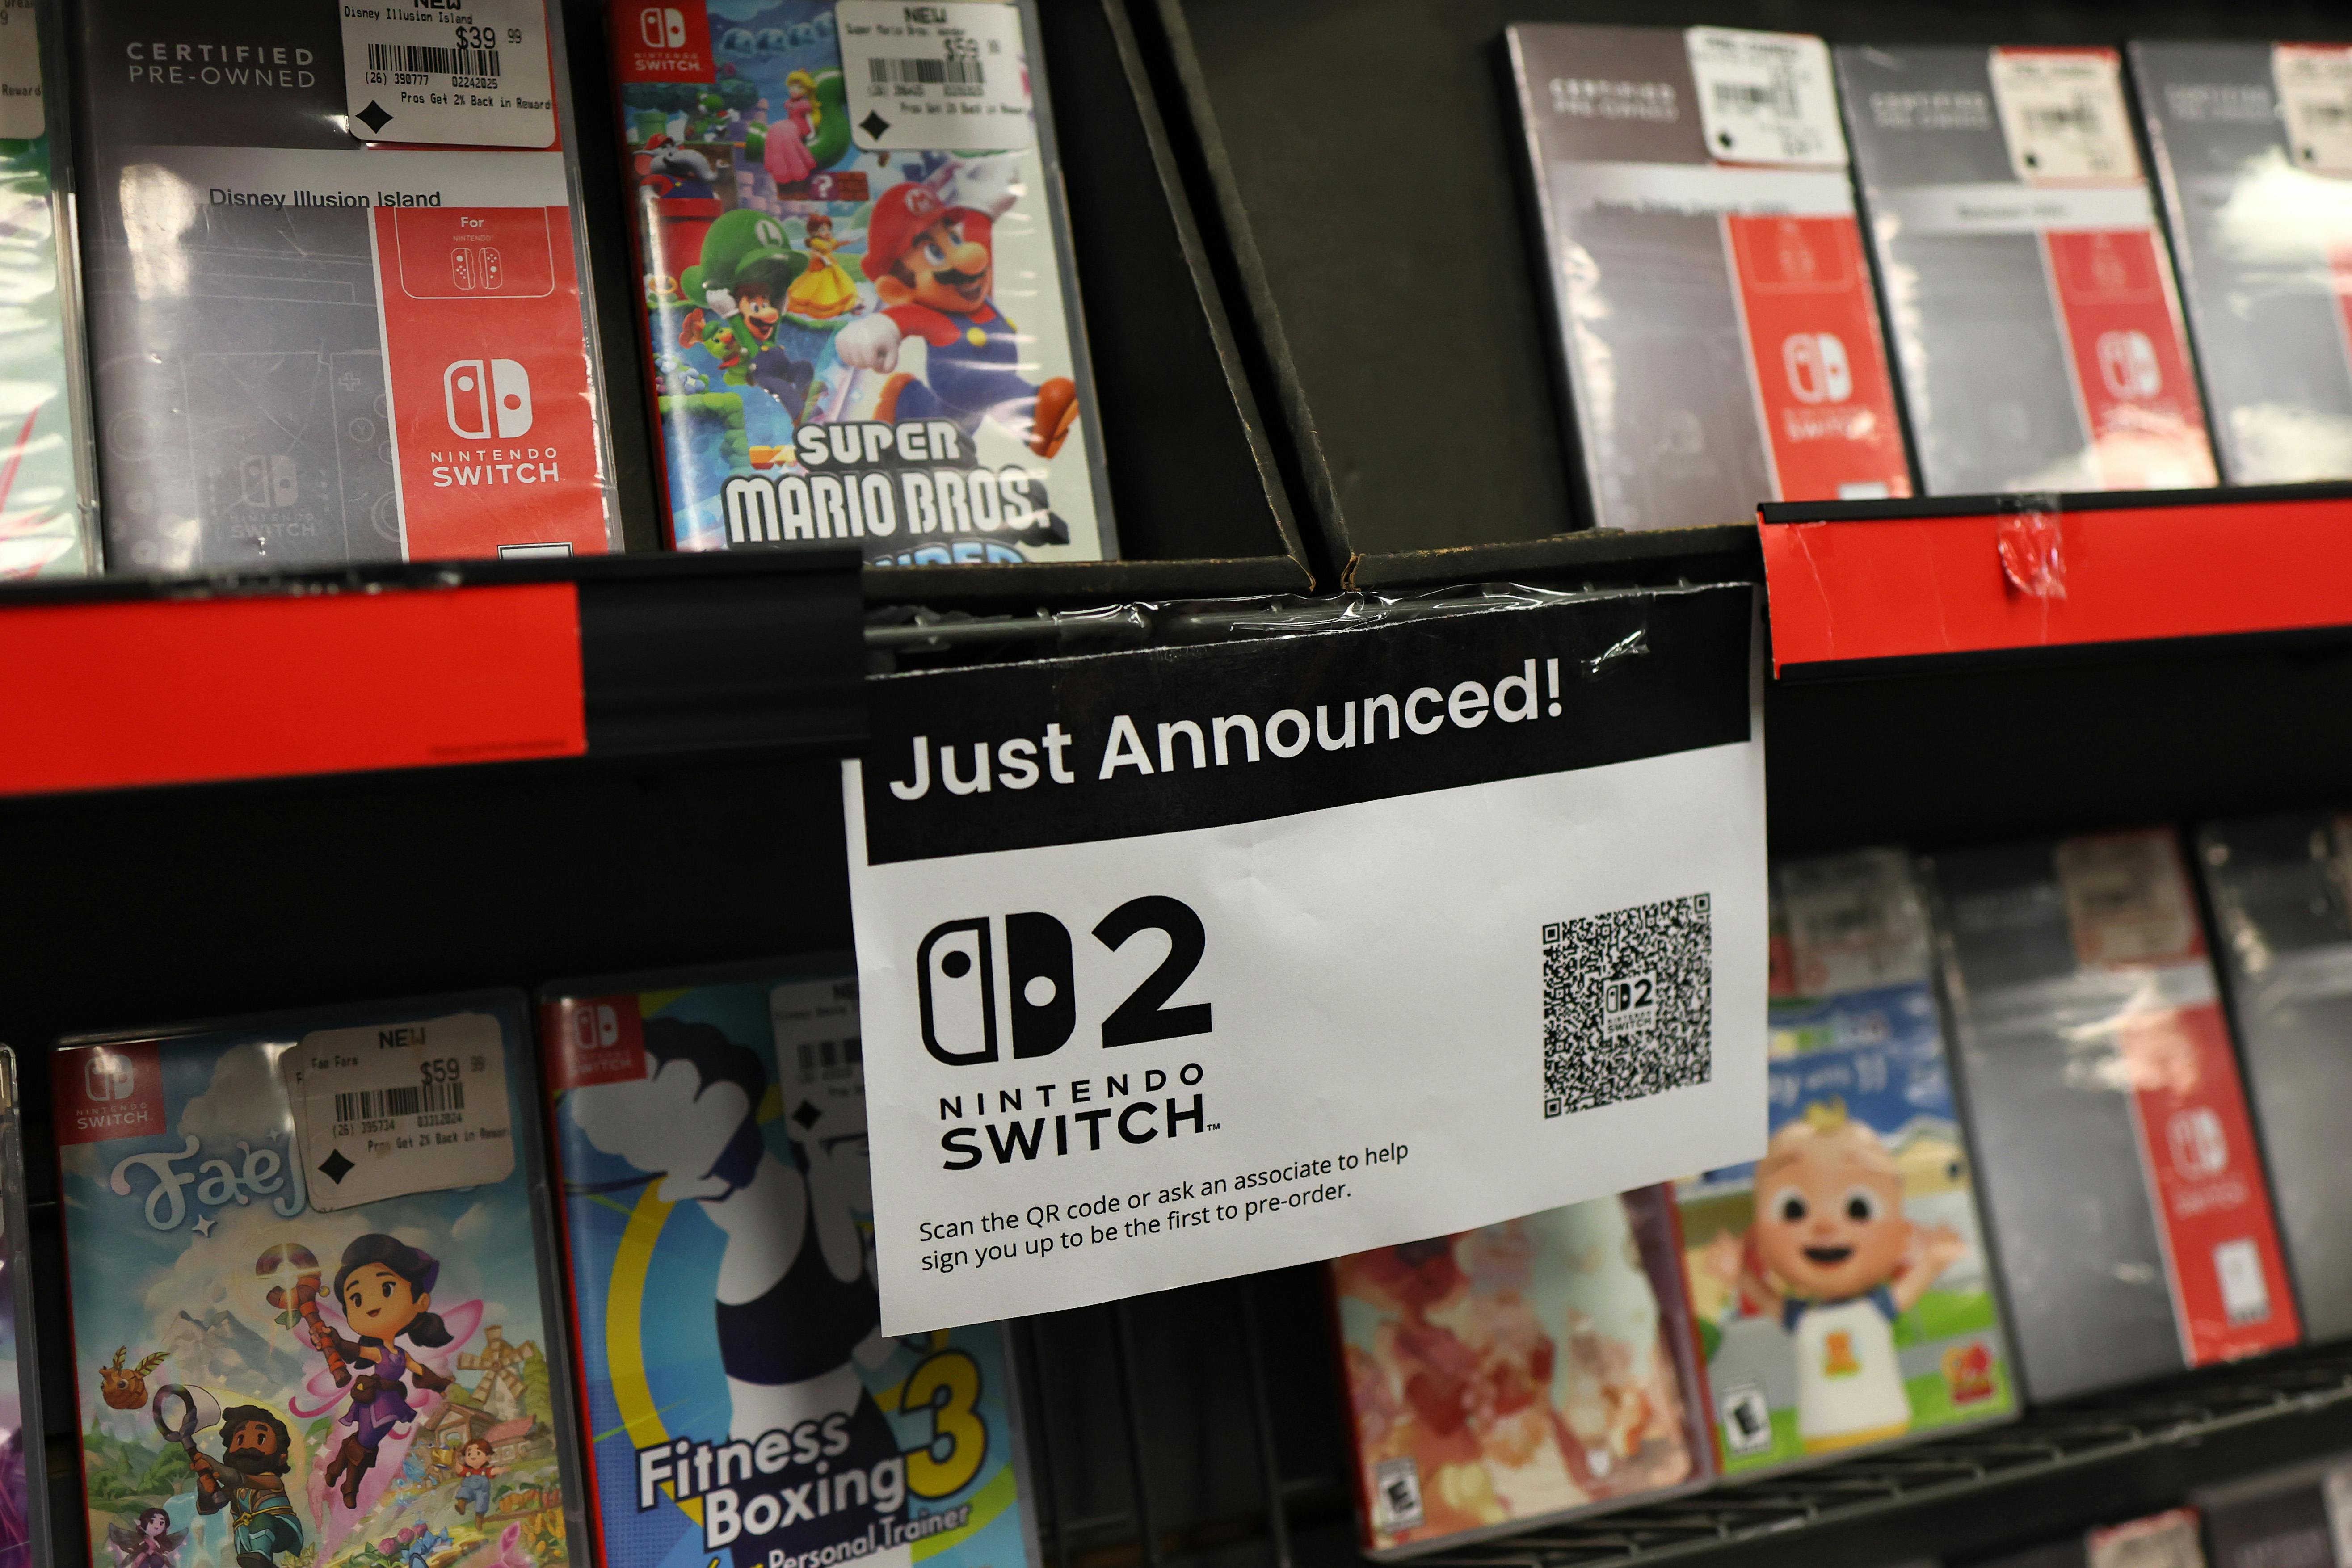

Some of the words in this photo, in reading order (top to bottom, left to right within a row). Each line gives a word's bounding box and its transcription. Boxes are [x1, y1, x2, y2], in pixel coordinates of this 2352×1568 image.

[345, 6, 380, 20] Disney
[387, 8, 433, 22] Illusion
[439, 11, 473, 24] Island
[904, 6, 947, 24] NEW
[455, 26, 496, 50] $39
[507, 28, 522, 43] 99
[126, 42, 313, 66] CERTIFIED
[635, 59, 701, 71] SWITCH
[129, 65, 316, 88] PRE-OWNED
[366, 72, 387, 85] (26)
[452, 76, 498, 89] 02242025
[401, 92, 425, 104] Pros
[430, 93, 448, 104] Get
[454, 94, 465, 105] 2%
[471, 95, 493, 107] Back
[501, 97, 512, 108] in
[209, 188, 286, 211] Disney
[294, 190, 370, 208] Illusion
[378, 191, 442, 207] Island
[461, 217, 484, 227] For
[431, 447, 557, 463] NINTENDO
[796, 421, 960, 465] SUPER
[432, 462, 559, 487] SWITCH
[726, 473, 897, 542] MARIO
[889, 723, 1074, 801] Just
[1099, 658, 1563, 780] Announced!
[1092, 895, 1212, 1048] 2
[379, 1028, 426, 1049] NEW
[421, 1058, 459, 1085] $59
[940, 1063, 1203, 1120] NINTENDO
[76, 1102, 147, 1116] NINTENDO
[77, 1111, 148, 1129] SWITCH
[941, 1094, 1203, 1170] SWITCH
[110, 1135, 284, 1230] Fae
[919, 1220, 974, 1241] Scan
[982, 1213, 1019, 1234] the
[1027, 1204, 1060, 1229] QR
[1067, 1195, 1120, 1219] code
[1128, 1191, 1151, 1209] or
[1158, 1181, 1195, 1204] ask
[1201, 1178, 1227, 1196] an
[1234, 1160, 1332, 1190] associate
[1338, 1154, 1359, 1171] to
[1366, 1142, 1409, 1165] help
[921, 1249, 968, 1273] sign
[975, 1241, 1017, 1268] you
[1025, 1236, 1054, 1257] up
[1060, 1231, 1083, 1249] to
[1090, 1224, 1118, 1244] be
[1124, 1218, 1161, 1238] the
[1167, 1208, 1211, 1230] first
[1216, 1202, 1238, 1221] to
[1245, 1182, 1352, 1221] pre-order.
[901, 1350, 986, 1499] 3
[638, 1416, 850, 1509] Fitness
[705, 1458, 906, 1549] Boxing
[769, 1523, 875, 1568] Personal
[879, 1504, 971, 1547] Trainer
